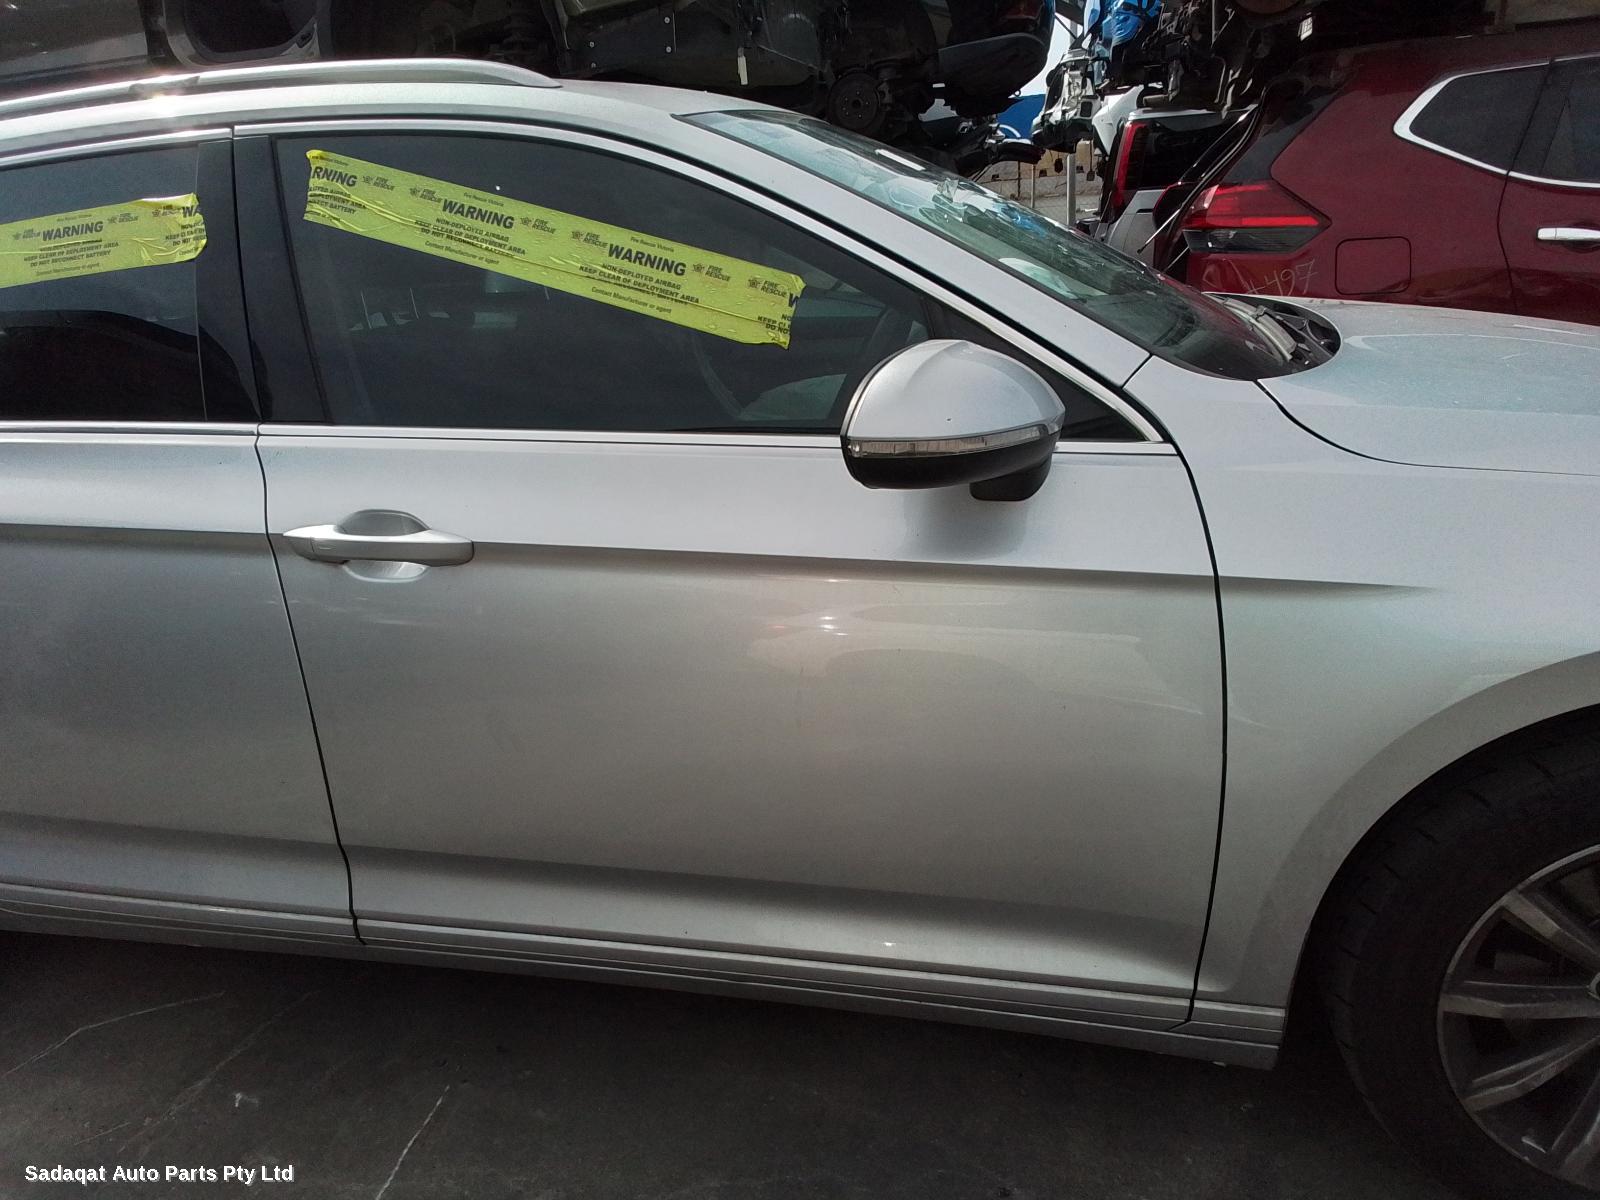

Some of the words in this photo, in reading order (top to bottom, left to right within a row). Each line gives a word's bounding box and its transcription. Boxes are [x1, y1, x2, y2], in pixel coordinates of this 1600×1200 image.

[312, 166, 357, 187] RNING
[442, 199, 515, 229] WARNING
[42, 220, 104, 242] WARNING
[436, 217, 483, 235] NON-DEPLOYED
[484, 231, 510, 243] AIRBAG
[585, 232, 600, 240] FIRE
[432, 224, 453, 235] CLEAR
[464, 233, 507, 249] DEPLOYMENT
[508, 245, 526, 255] AREA
[582, 237, 608, 249] RESCUE
[608, 243, 687, 276] WARNING
[708, 264, 723, 272] FIRE
[579, 265, 597, 274] KEEP
[598, 271, 621, 281] CLEAR
[622, 277, 632, 285] OF
[633, 280, 679, 298] DEPLOYMENT
[680, 293, 699, 303] AREA
[601, 263, 653, 282] NON-DEPLOYED
[655, 278, 681, 290] AIRBAG
[705, 270, 731, 281] RESCUE
[591, 286, 612, 297] Contact
[760, 285, 787, 298] RESCUE
[763, 280, 779, 289] FIRE
[765, 323, 776, 331] DO
